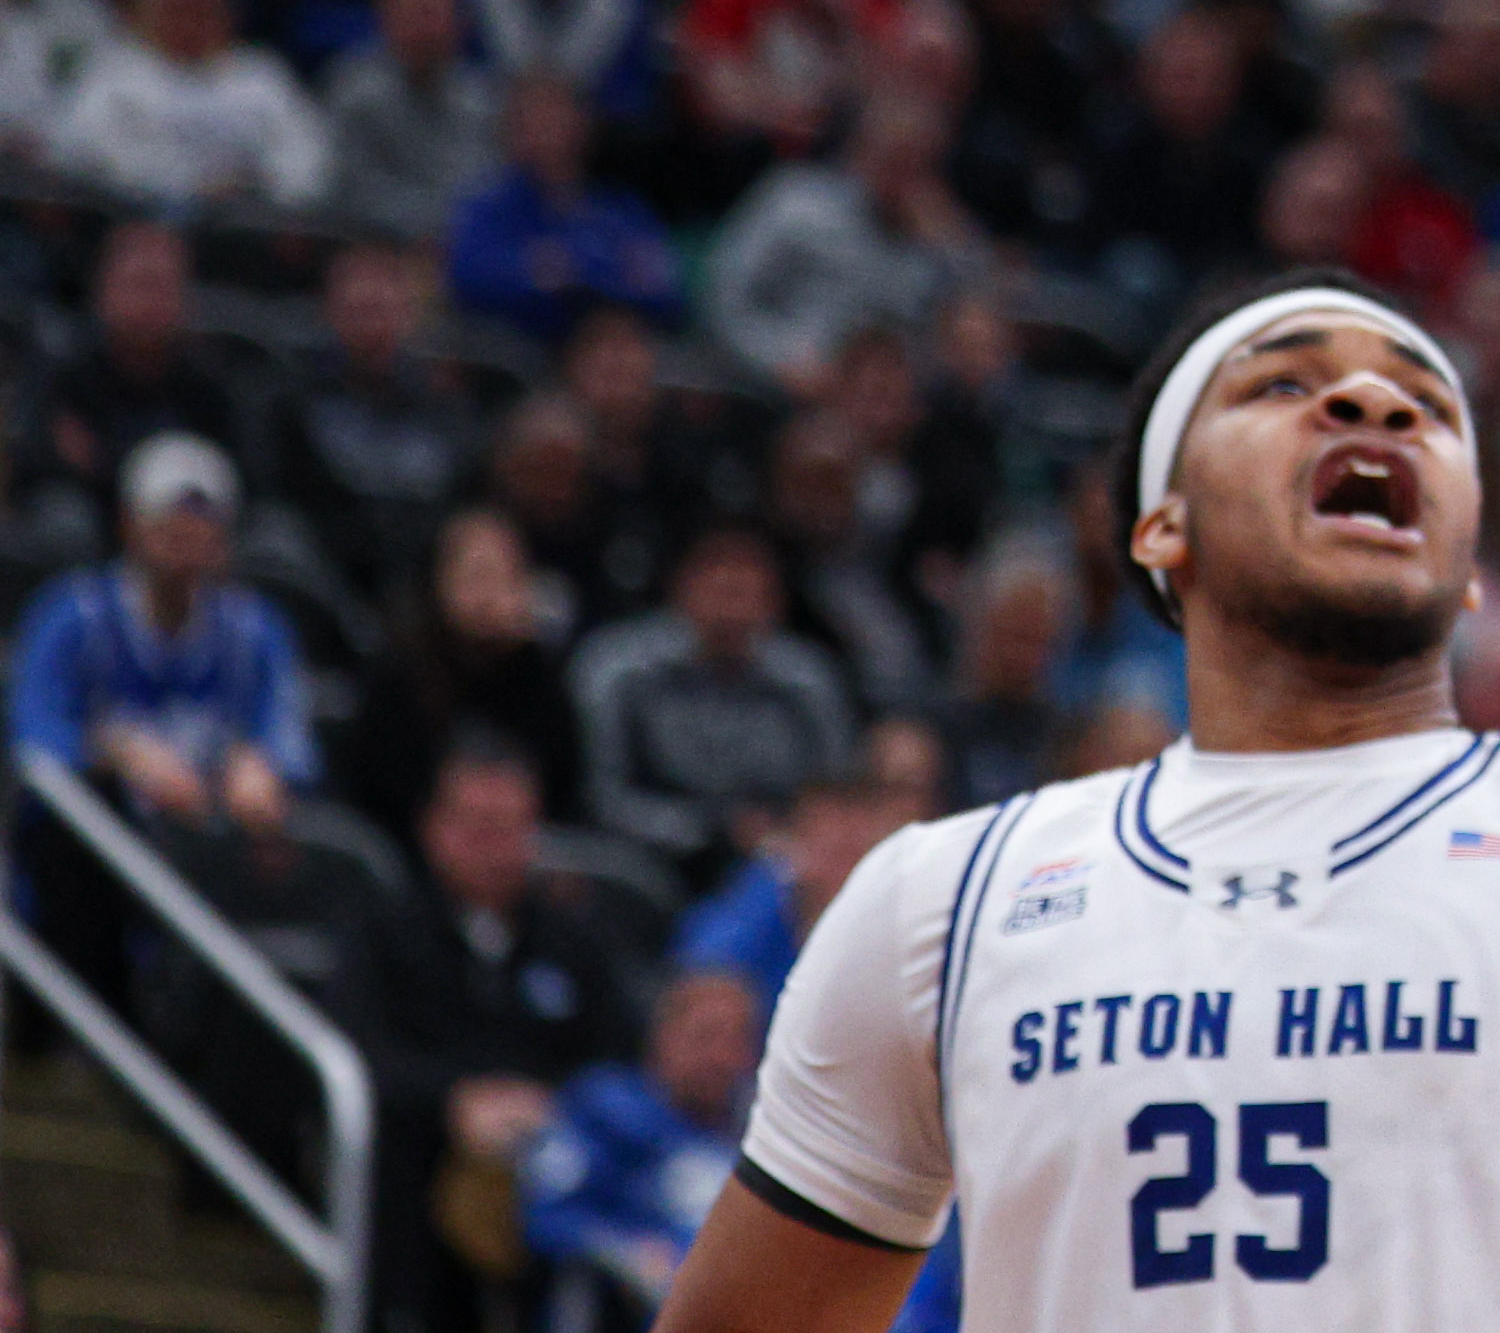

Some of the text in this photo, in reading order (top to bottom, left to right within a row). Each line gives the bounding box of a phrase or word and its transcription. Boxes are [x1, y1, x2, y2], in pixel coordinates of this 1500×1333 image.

[1010, 979, 1479, 1085] SETON HALL
[1125, 1100, 1331, 1291] 25
